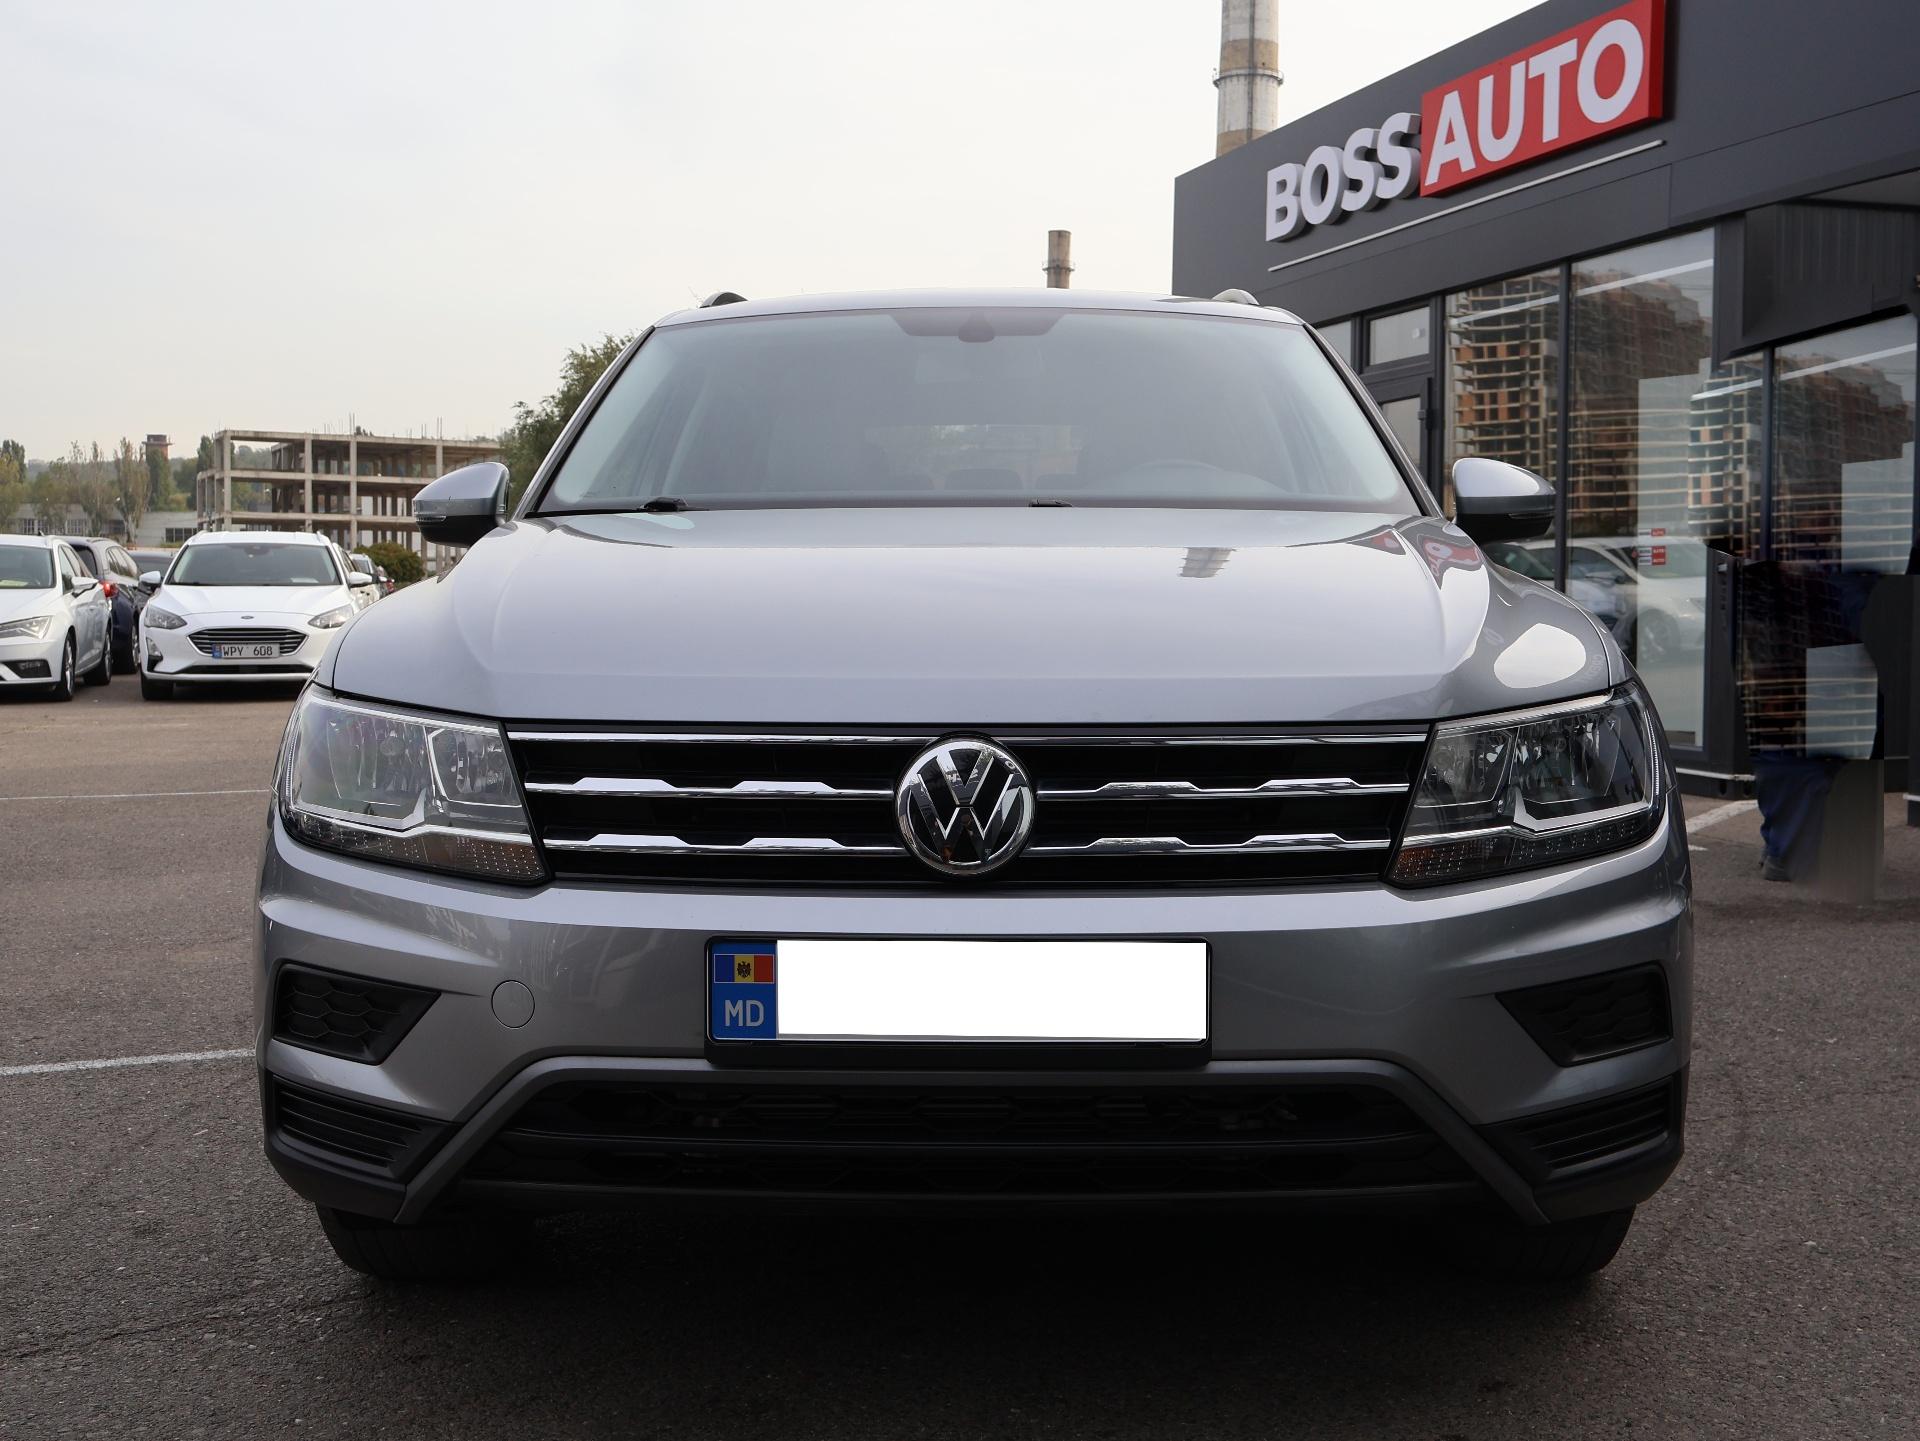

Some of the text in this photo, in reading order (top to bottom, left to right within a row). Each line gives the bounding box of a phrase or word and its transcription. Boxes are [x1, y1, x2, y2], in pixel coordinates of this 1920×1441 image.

[1266, 19, 1644, 242] BOSS AUTO
[223, 645, 273, 656] WPY 608
[724, 999, 765, 1027] MD
